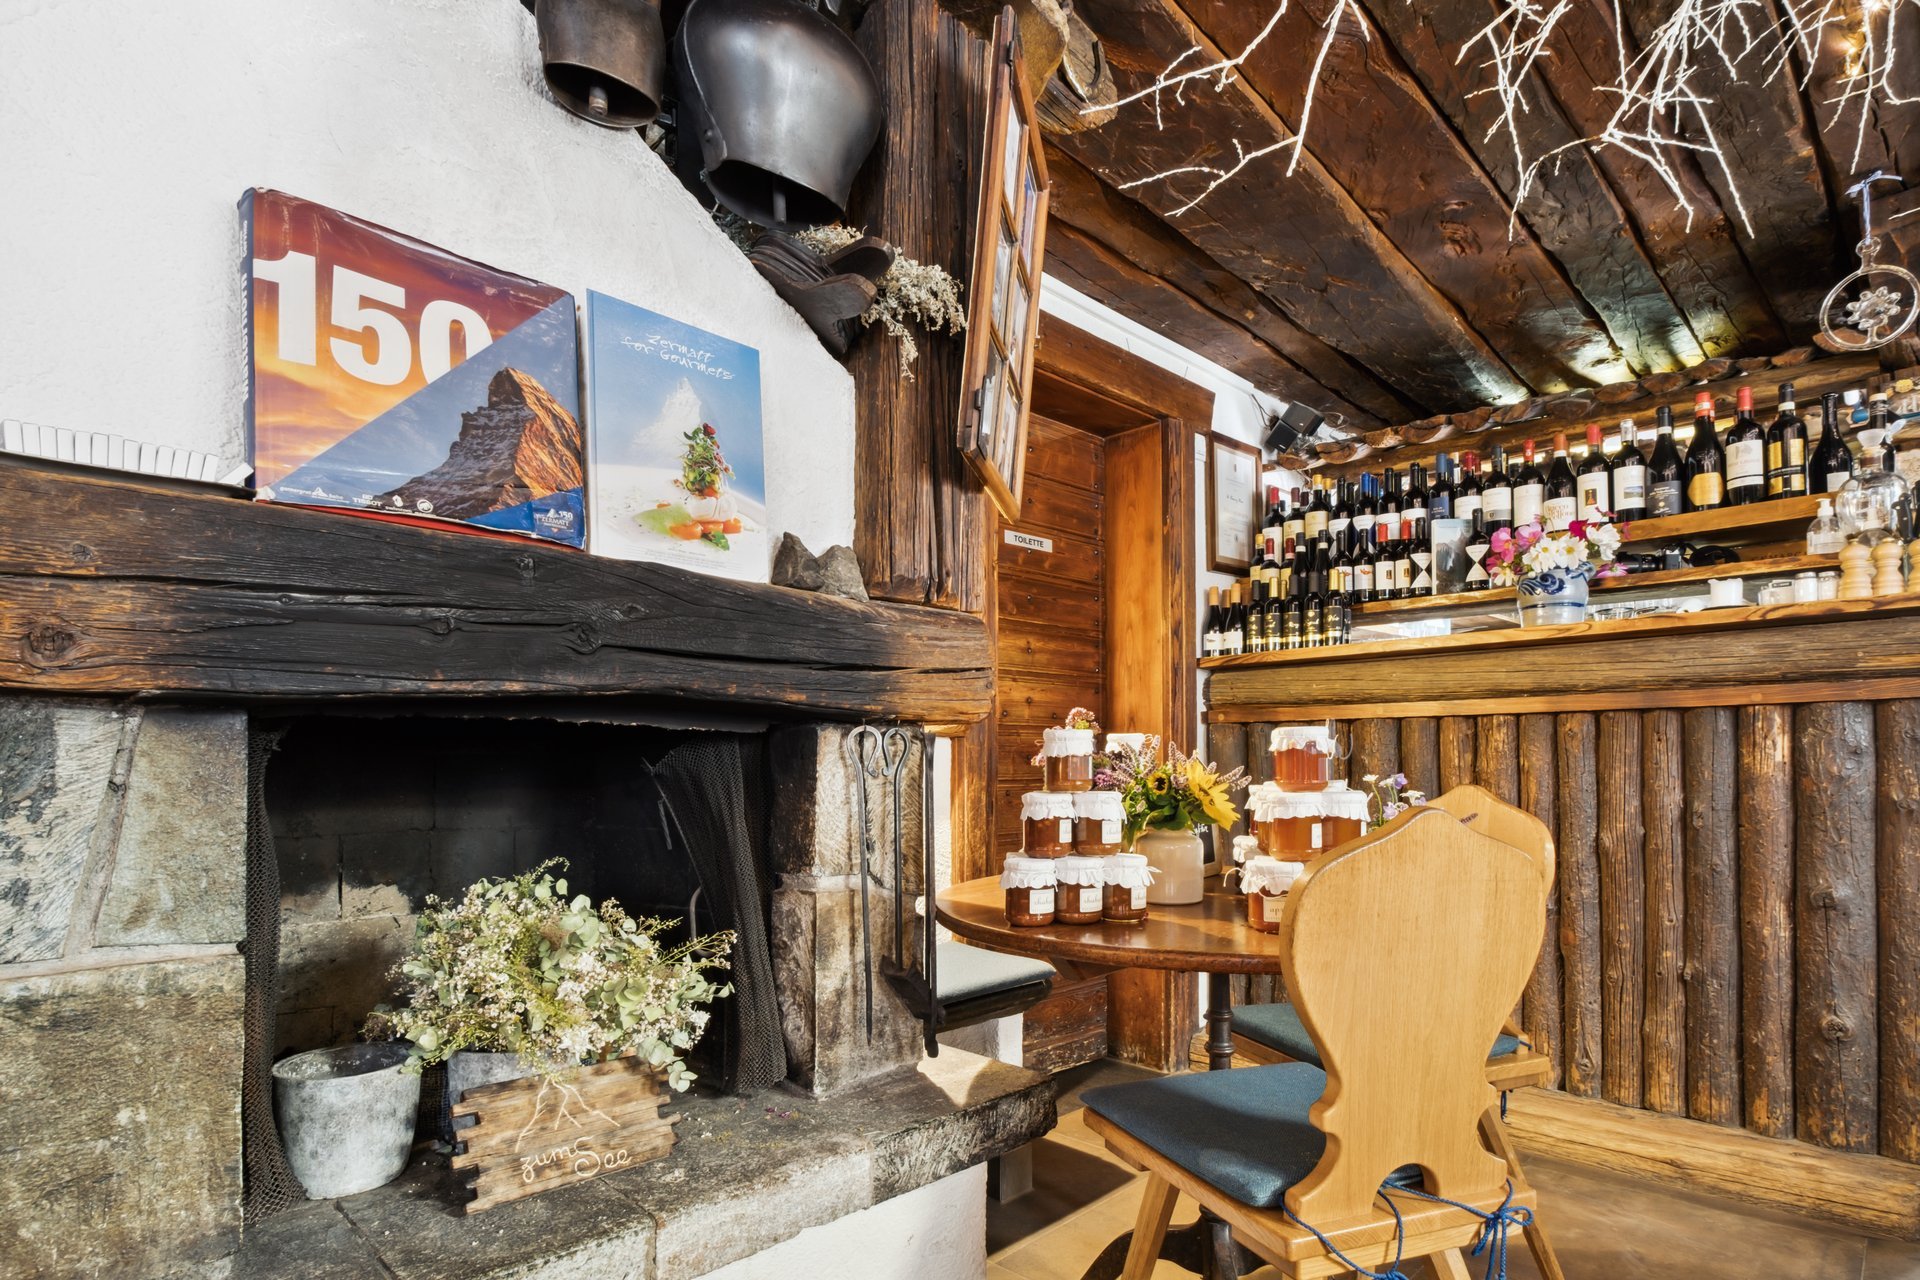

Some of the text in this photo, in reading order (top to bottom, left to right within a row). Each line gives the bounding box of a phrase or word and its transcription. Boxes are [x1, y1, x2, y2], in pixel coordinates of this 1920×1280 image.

[253, 250, 493, 386] 150
[241, 272, 249, 401] Matterhorn
[645, 333, 715, 362] Zermatt
[620, 336, 735, 380] for Gourmets
[353, 497, 382, 507] TISSOT
[1013, 535, 1044, 548] TOILETTE
